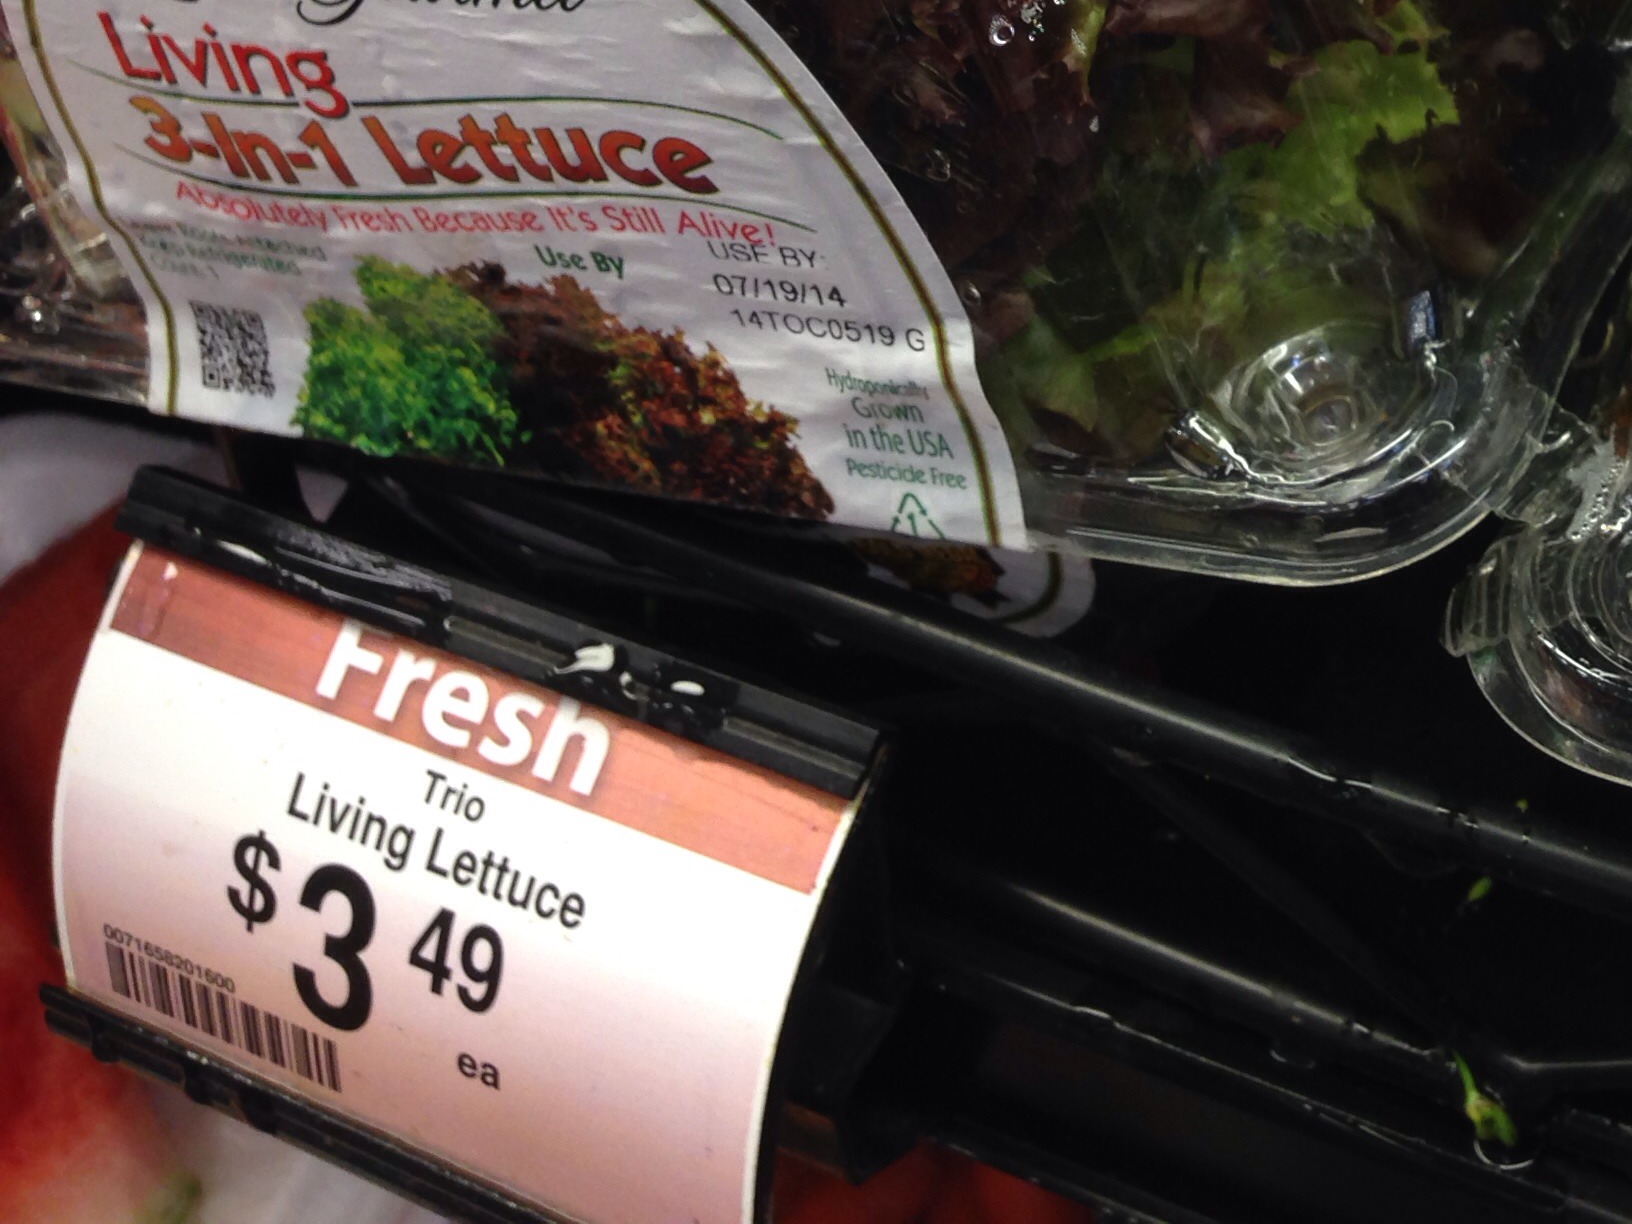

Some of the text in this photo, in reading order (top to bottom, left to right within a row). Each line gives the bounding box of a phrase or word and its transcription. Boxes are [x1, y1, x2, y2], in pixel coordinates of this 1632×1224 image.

[97, 11, 349, 120] Living
[129, 95, 720, 194] 3-In-1 Lettuce
[176, 180, 777, 247] Absolutely Fresh Because It's Still Alive!
[534, 243, 624, 279] Use By
[708, 240, 768, 263] USE
[713, 274, 847, 307] 07/19/14
[906, 328, 925, 352] G
[851, 396, 925, 423] Grown
[843, 423, 955, 460] in the USA
[845, 457, 967, 490] Pesticide Free
[315, 621, 612, 797] Fresh
[424, 770, 486, 823] Trio
[287, 772, 586, 929] Living Lettuce
[457, 1049, 502, 1090] ea
